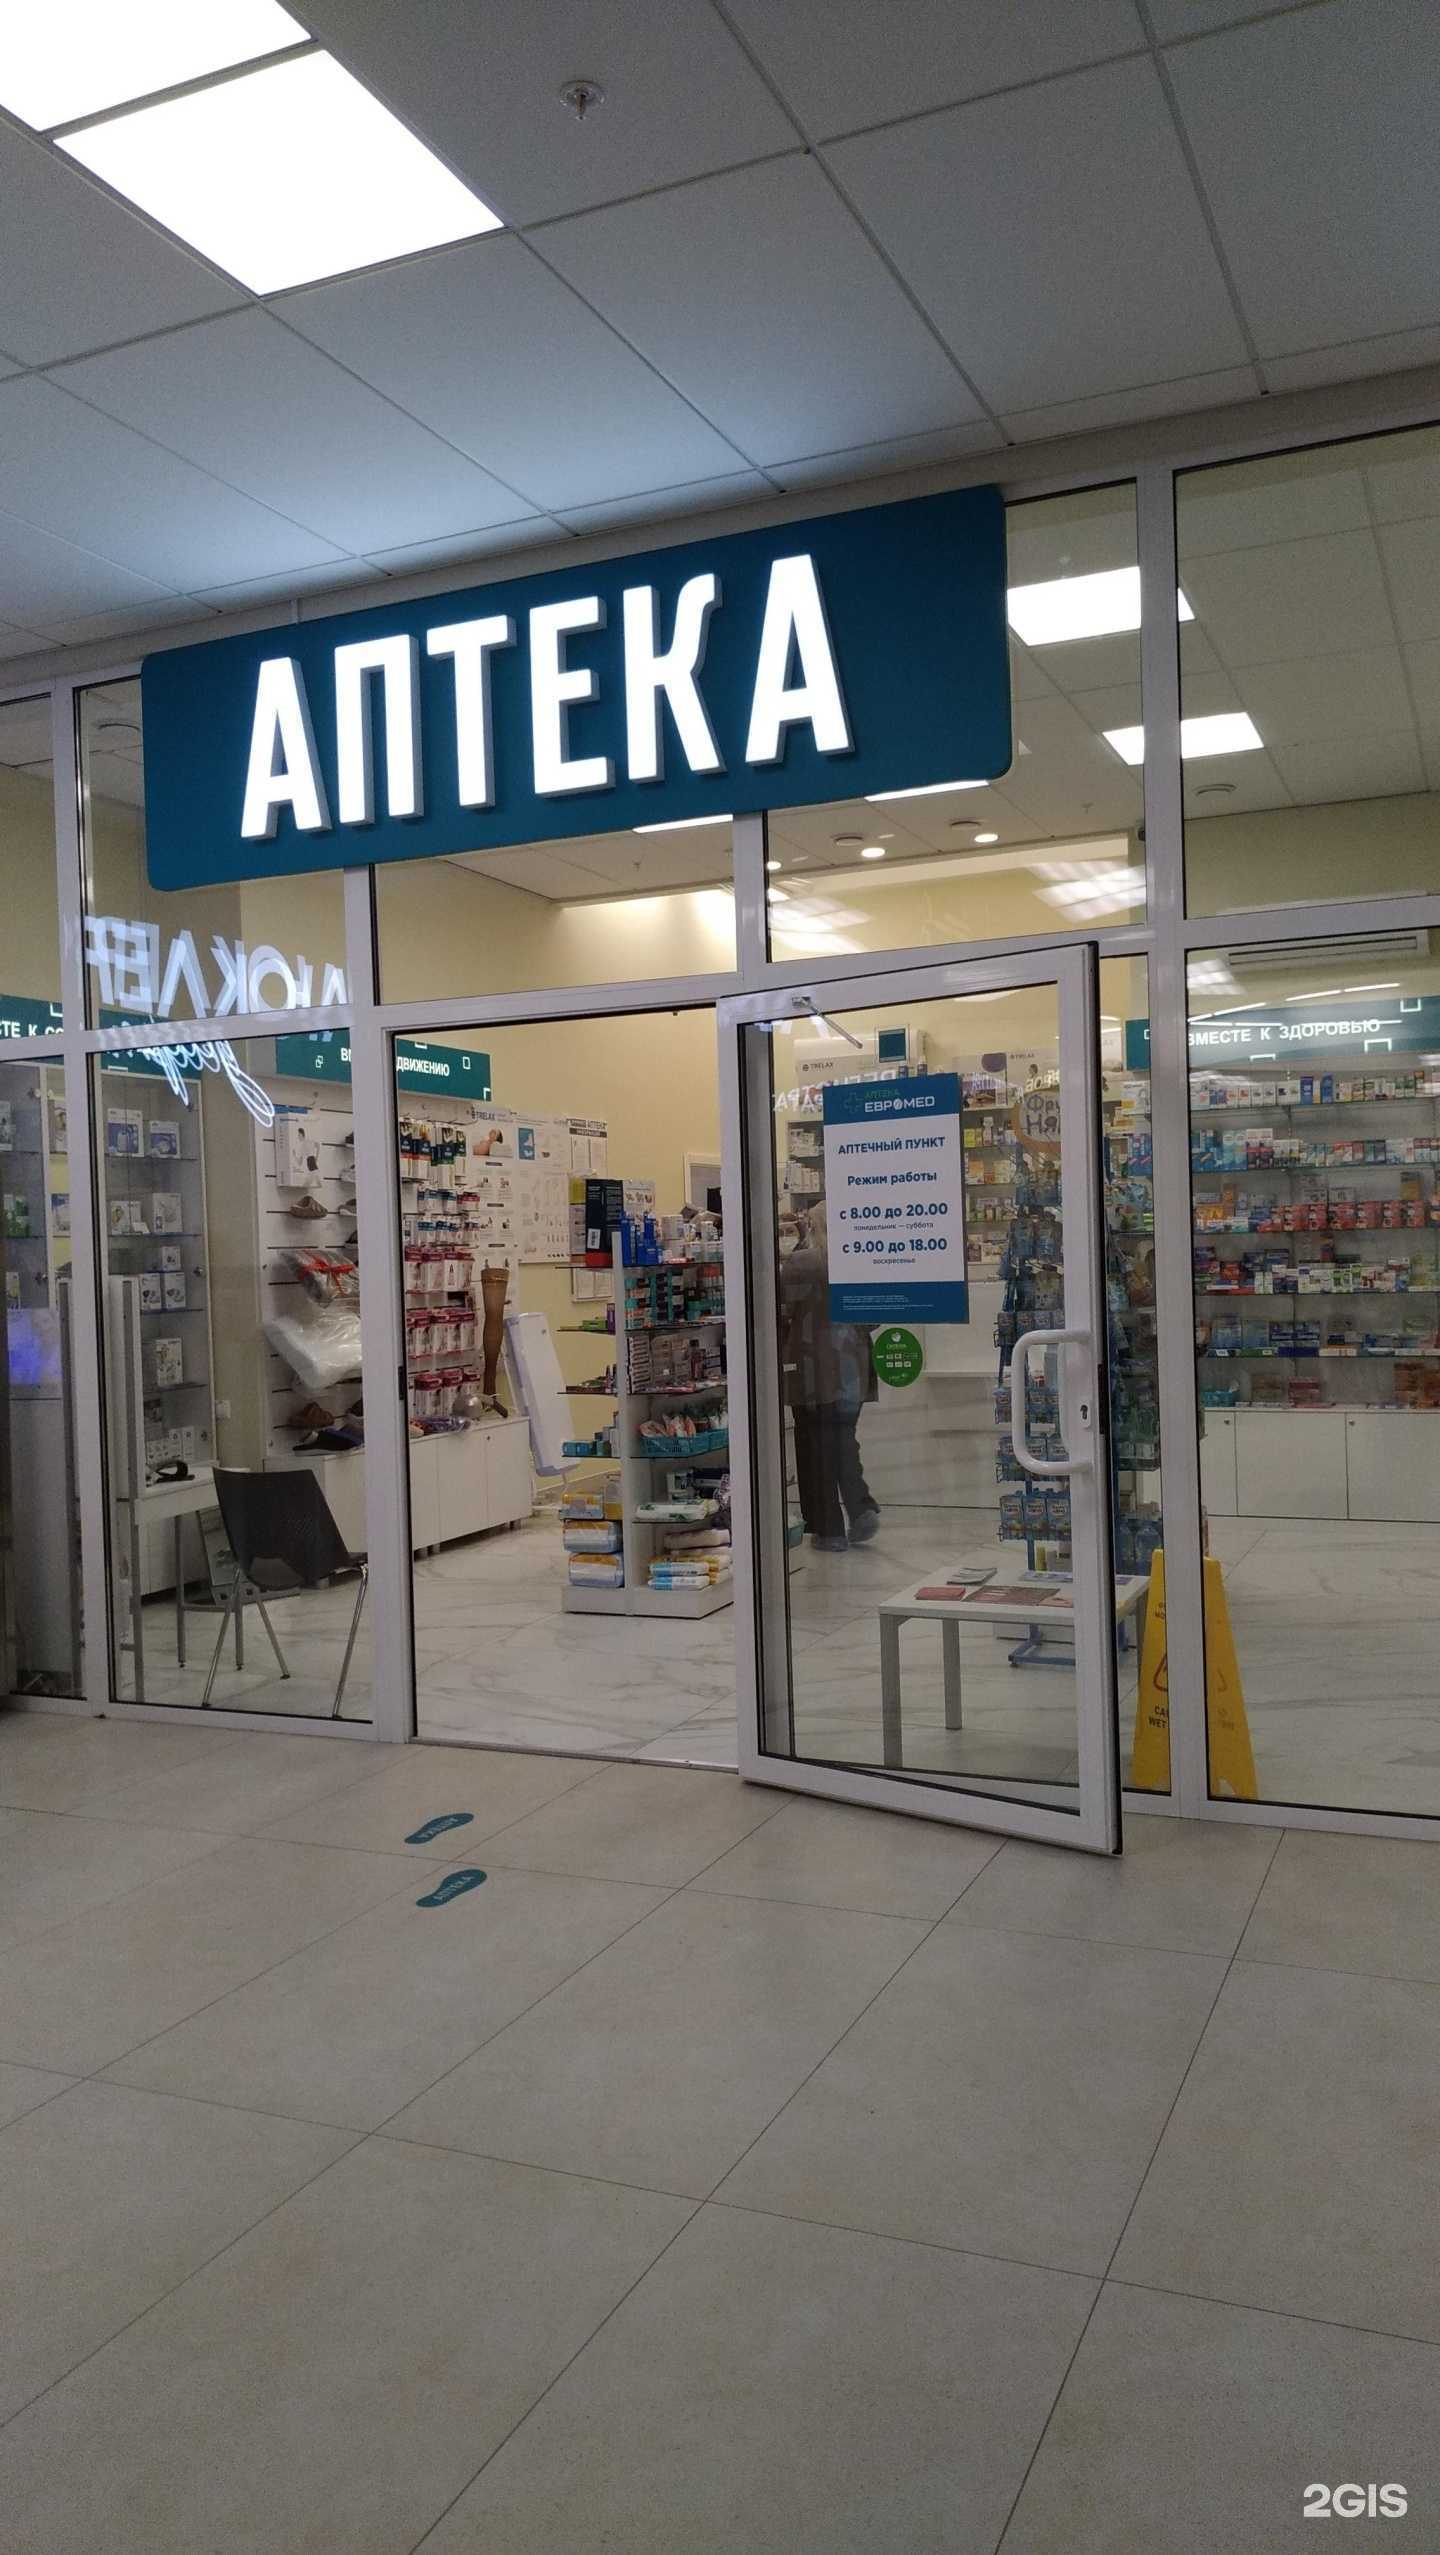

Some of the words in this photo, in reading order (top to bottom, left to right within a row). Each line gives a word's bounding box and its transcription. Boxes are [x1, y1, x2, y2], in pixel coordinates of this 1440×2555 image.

[241, 553, 855, 841] АПТЕКА
[1260, 1028, 1271, 1041] К
[1279, 1019, 1380, 1041] ЗДОРОВЬЮ
[396, 1055, 450, 1077] ДВИЖЕНИЮ
[838, 1137, 902, 1155] АПТЕЧНЫЙ
[905, 1136, 945, 1151] ПУНКТ
[847, 1173, 887, 1187] Режим
[891, 1171, 937, 1186] работы
[839, 1209, 847, 1220] с
[850, 1206, 881, 1220] 8.00
[884, 1207, 902, 1220] до
[906, 1203, 948, 1217] 20.00
[906, 1221, 934, 1231] суббота
[842, 1243, 849, 1254] с
[853, 1240, 884, 1253] 9.00
[888, 1242, 906, 1254] до
[909, 1238, 948, 1251] 18.00
